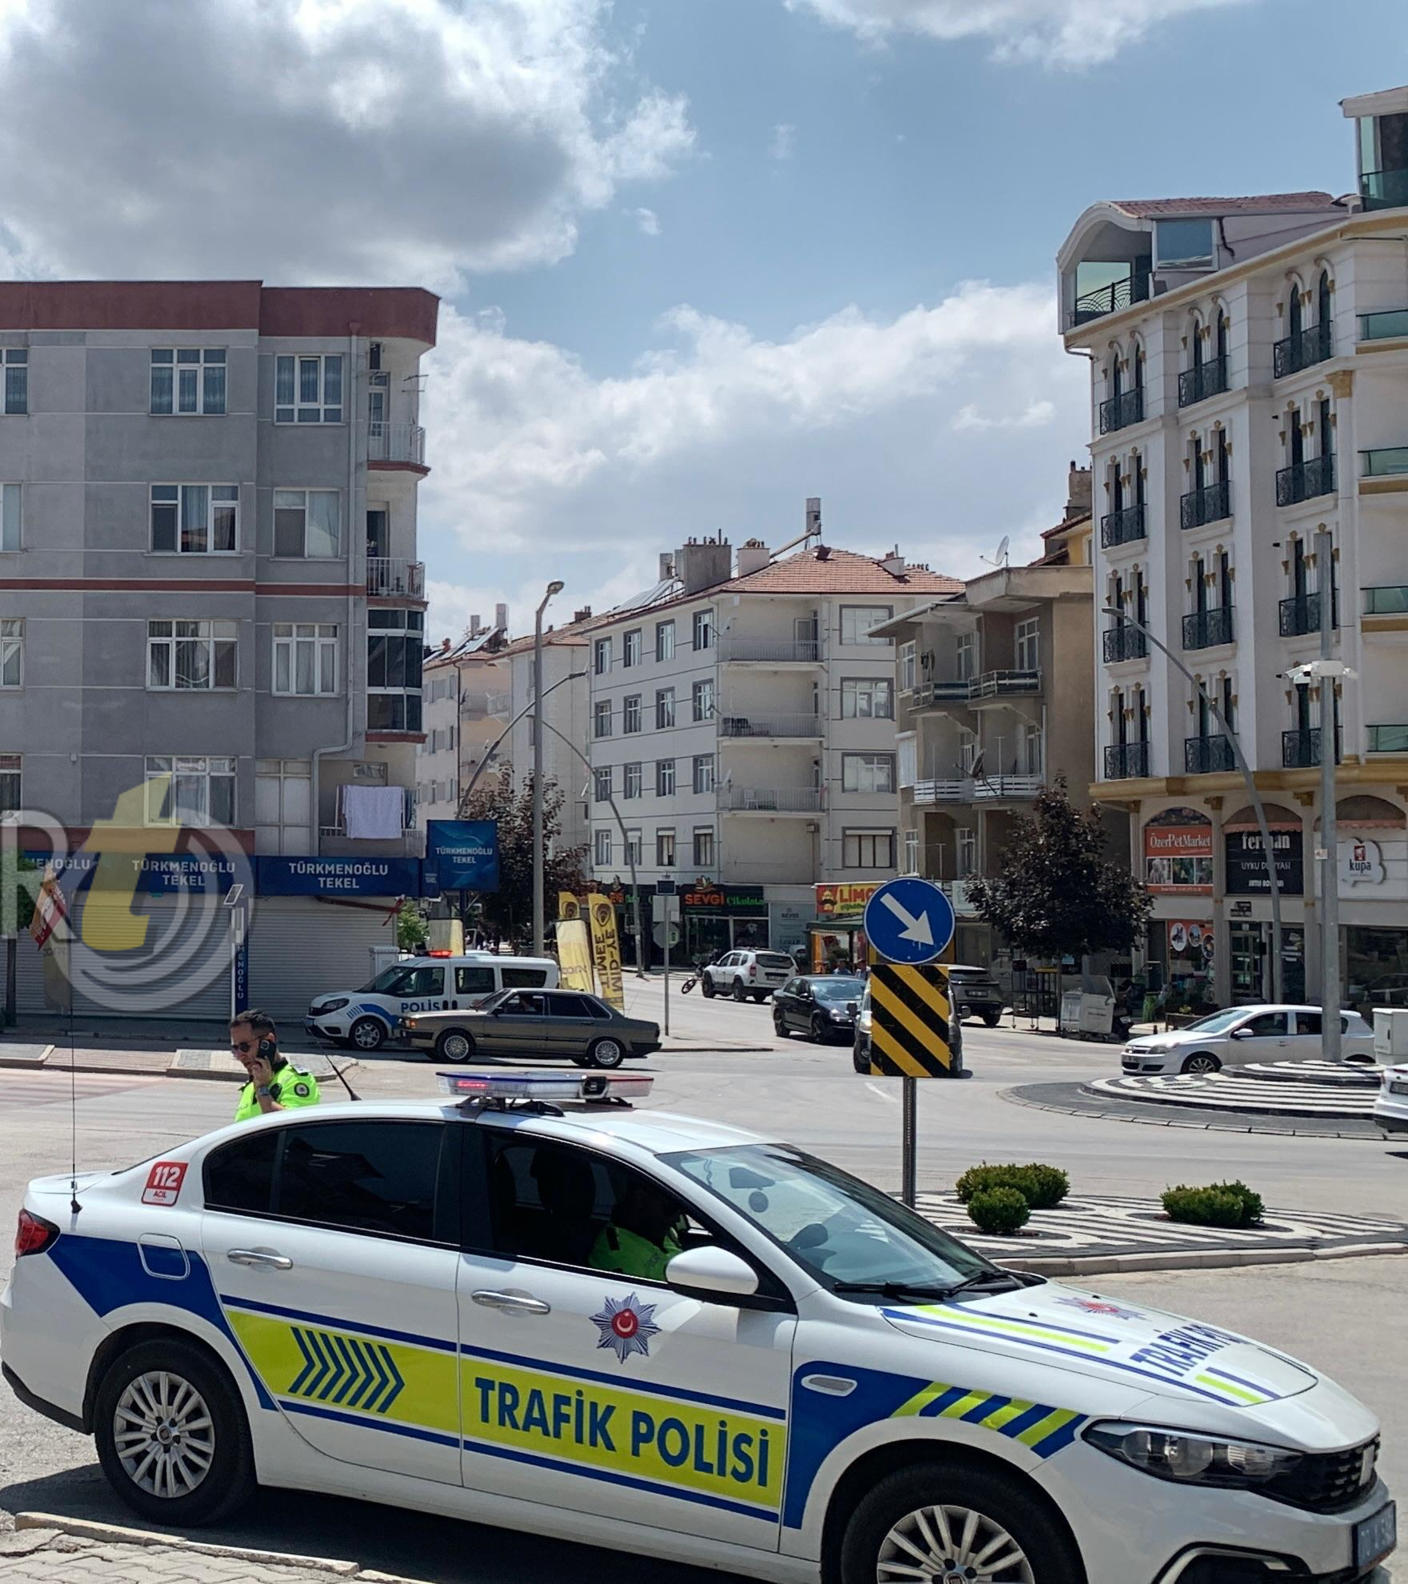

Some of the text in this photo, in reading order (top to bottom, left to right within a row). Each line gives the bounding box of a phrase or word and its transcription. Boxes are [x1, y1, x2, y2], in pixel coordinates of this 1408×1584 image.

[132, 858, 236, 873] TÜRKMENOĞLU
[452, 856, 477, 864] TEKEL
[1261, 862, 1291, 870] DYASI
[1349, 858, 1372, 873] kupa
[289, 860, 389, 876] TÜRKMENOĞLU
[162, 874, 205, 887] TEKEL
[318, 877, 360, 889] TEKEL
[684, 890, 724, 906] SEVGİ
[401, 1000, 441, 1013] POLİS
[153, 1166, 180, 1187] 112
[475, 1376, 770, 1488] TRAFİK POLİSİ
